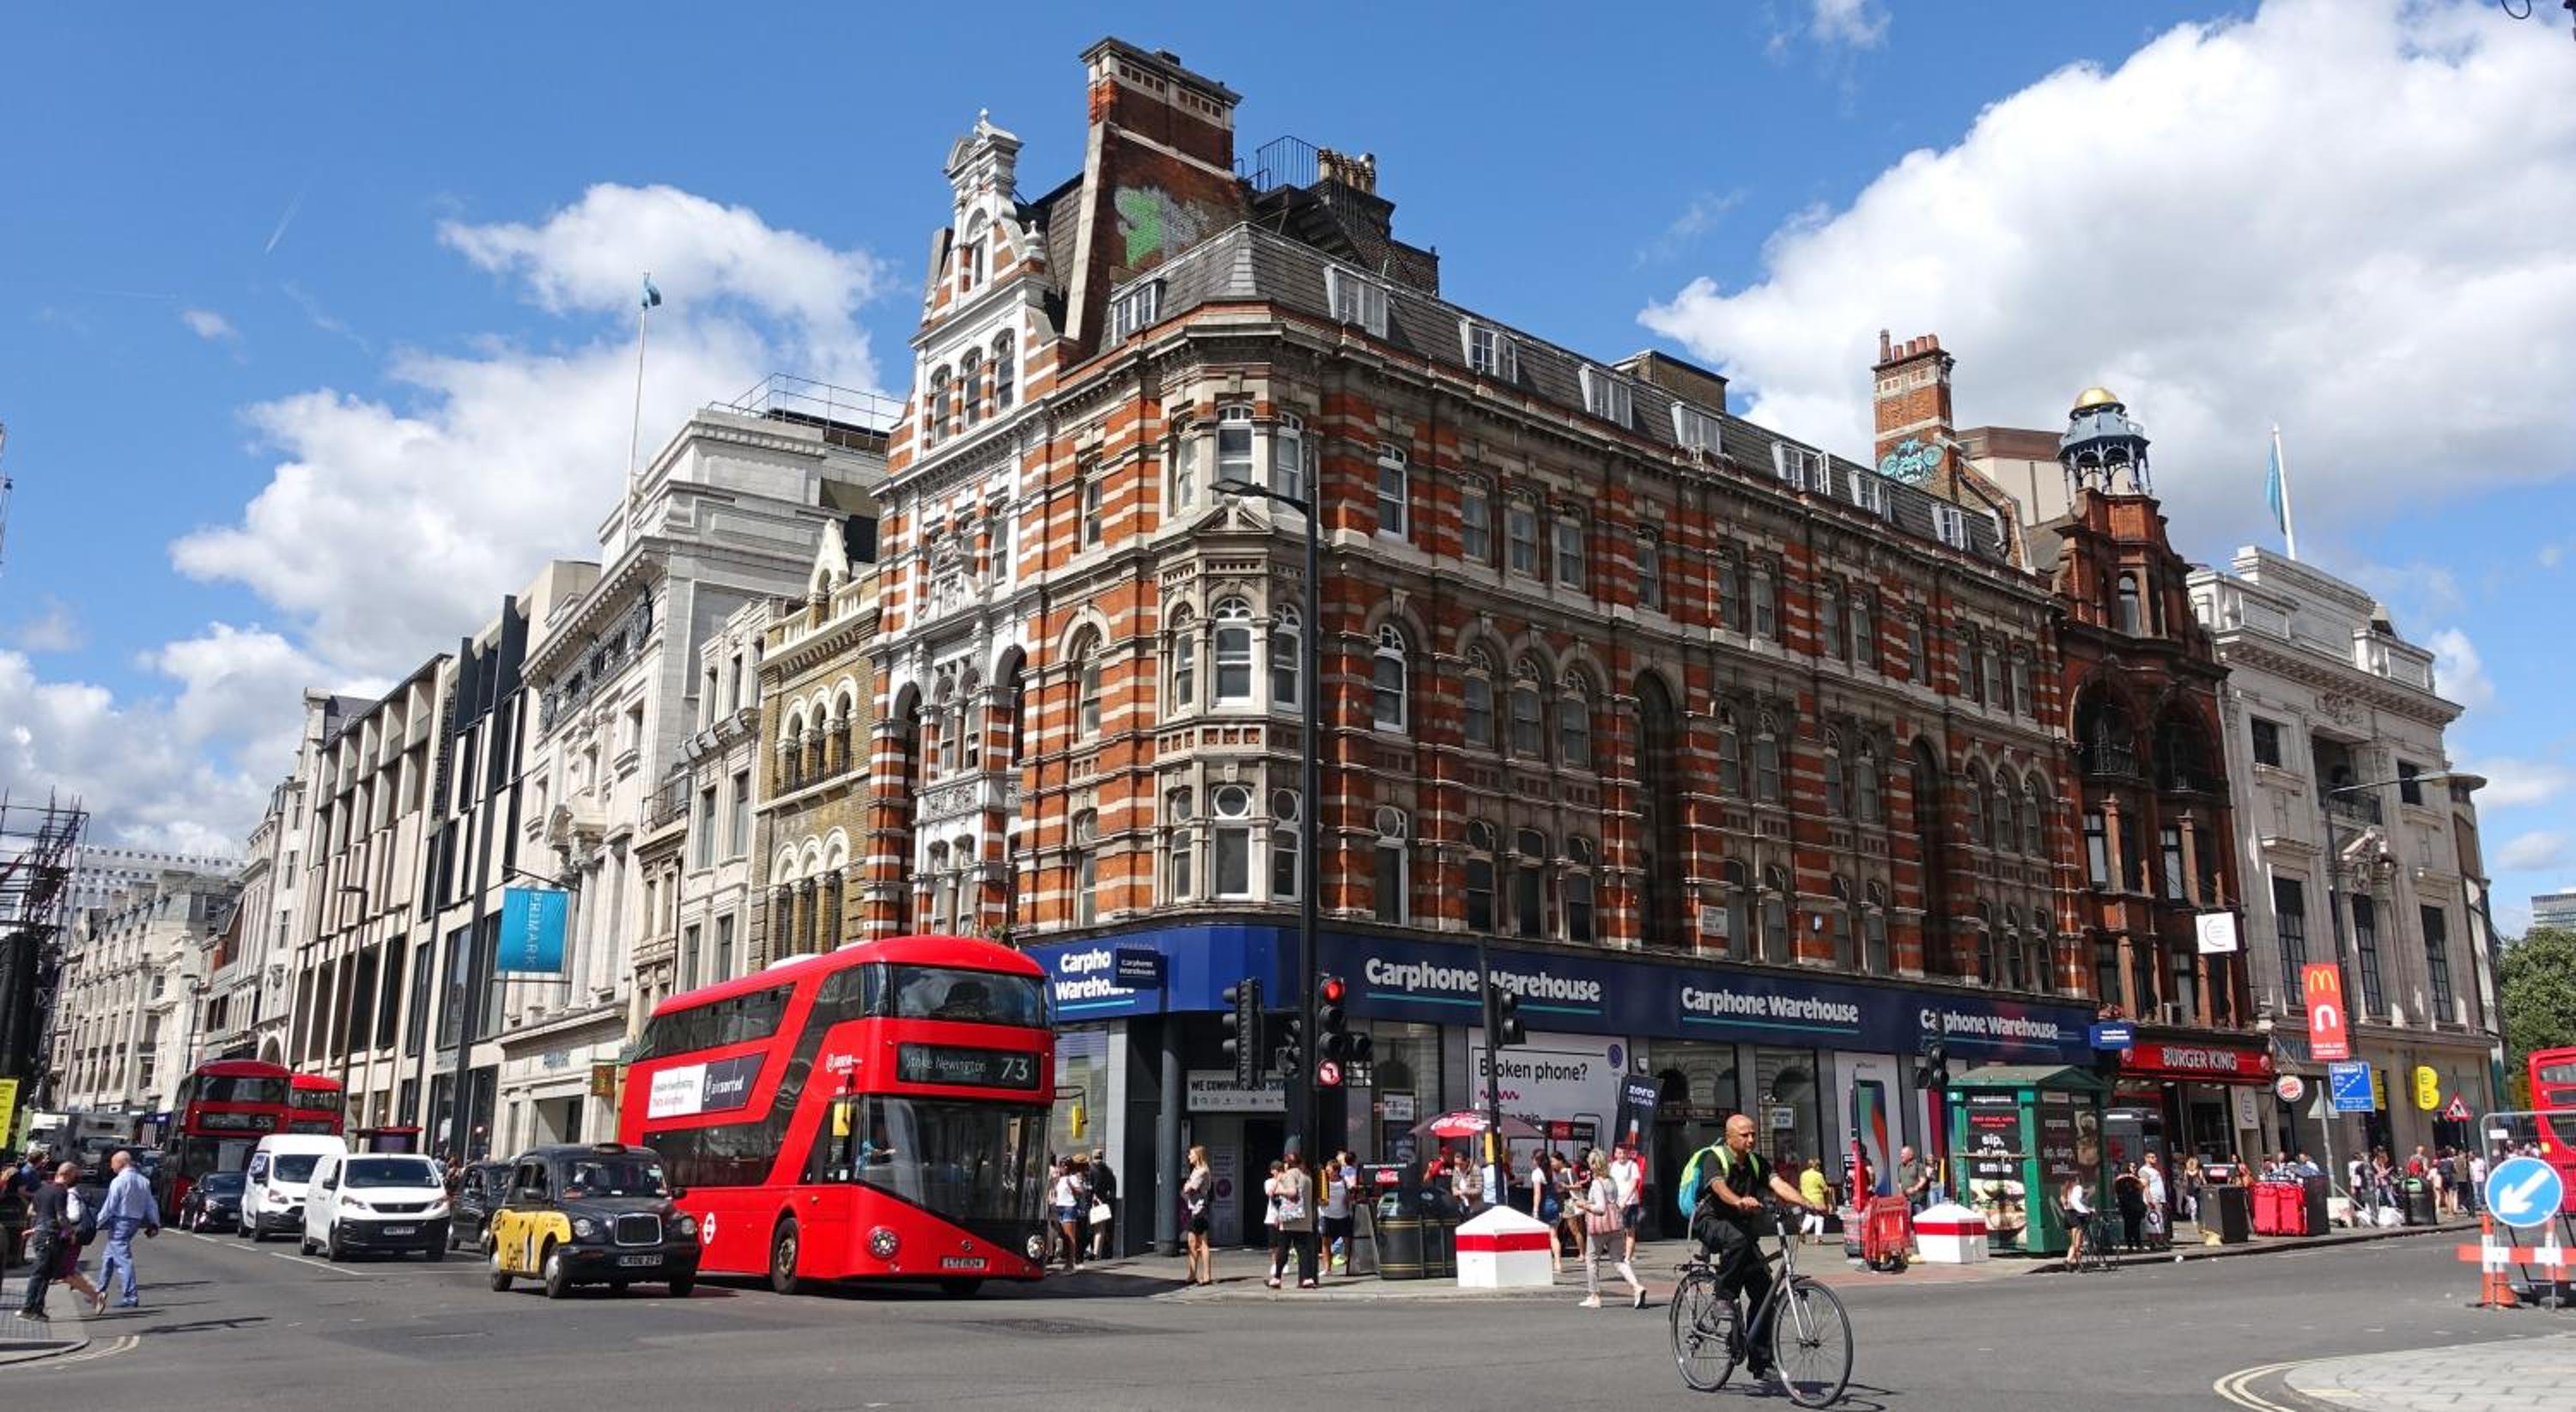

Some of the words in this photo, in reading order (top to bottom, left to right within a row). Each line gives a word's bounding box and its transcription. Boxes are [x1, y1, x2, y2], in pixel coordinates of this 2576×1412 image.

[1060, 947, 1111, 974] Carpho
[1365, 958, 1479, 991] Carphone
[1055, 976, 1135, 1001] Wareho
[1681, 987, 1767, 1016] Carphone
[1767, 995, 1859, 1023] Warehouse
[1920, 1008, 1987, 1034] Caphone
[1987, 1015, 2059, 1040] Warehouse
[1000, 1056, 1030, 1081] 73
[1479, 1057, 1531, 1080] Boken
[1535, 1061, 1589, 1084] phone?
[2163, 1046, 2208, 1069] BURGER
[2208, 1050, 2238, 1070] KING
[1628, 1085, 1656, 1099] zero
[1981, 1133, 2005, 1147] sip,
